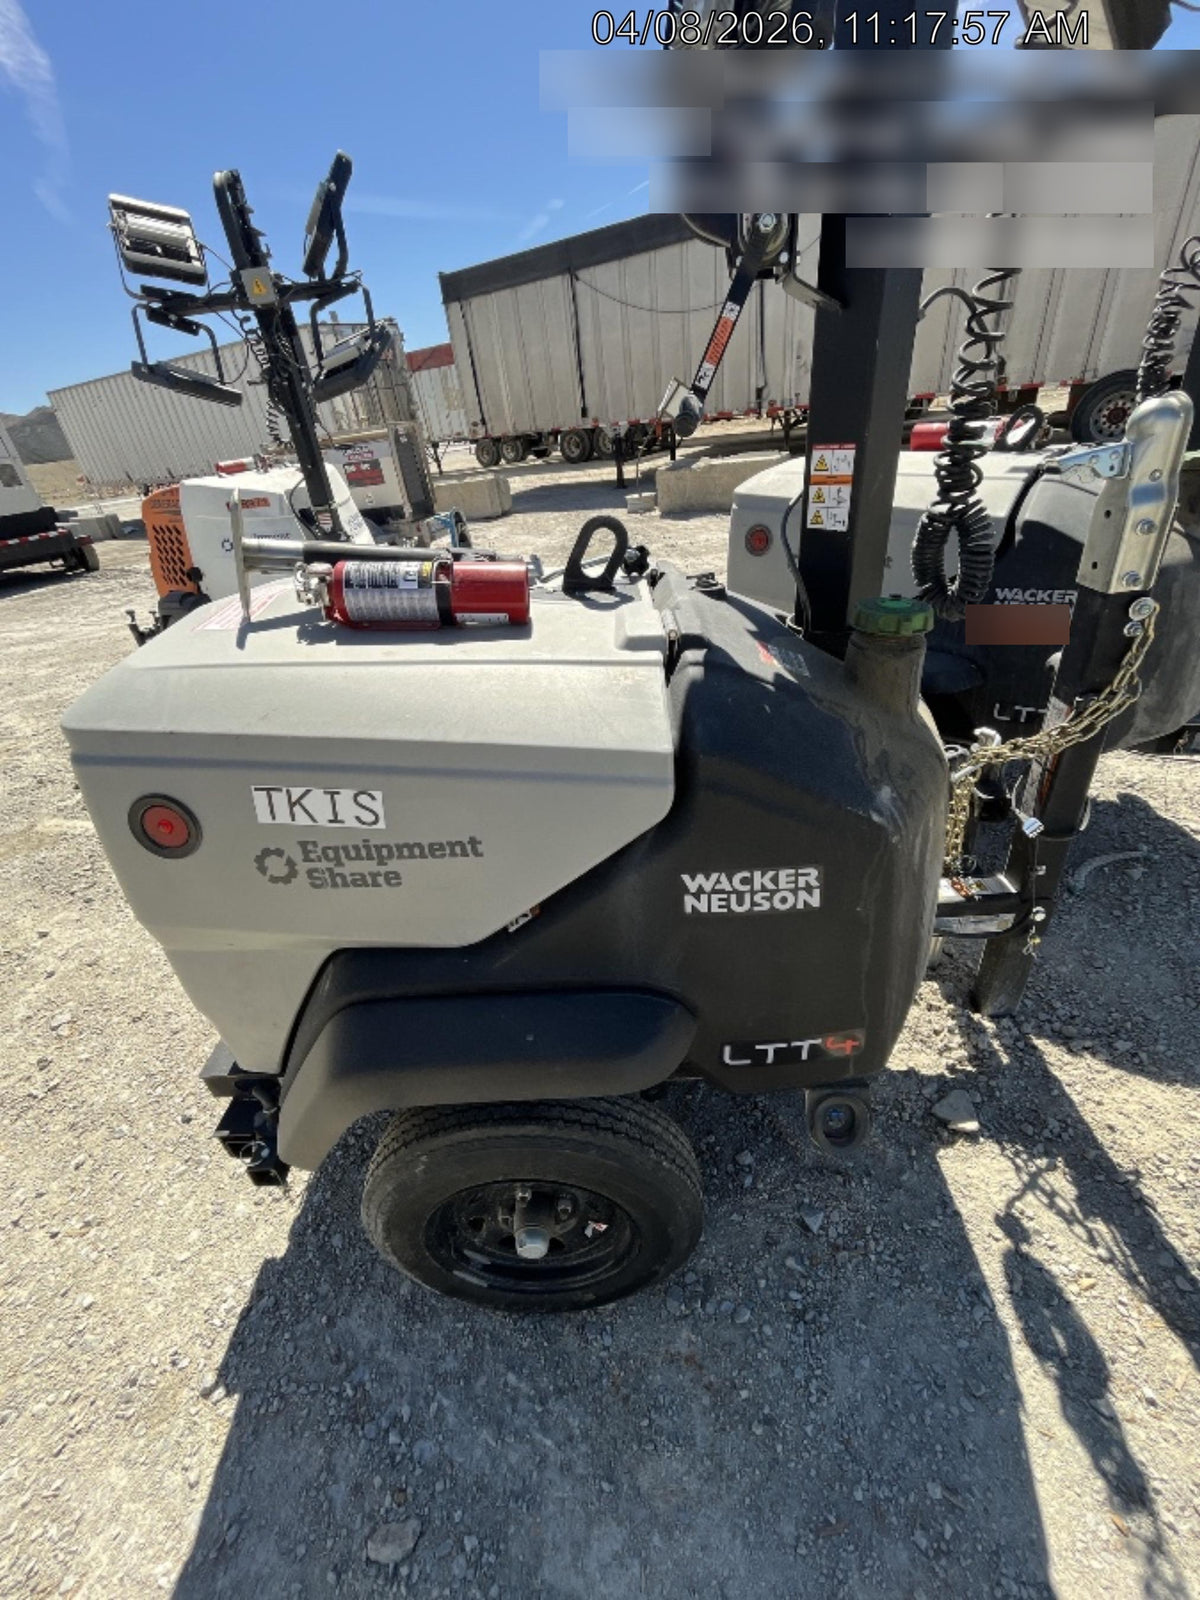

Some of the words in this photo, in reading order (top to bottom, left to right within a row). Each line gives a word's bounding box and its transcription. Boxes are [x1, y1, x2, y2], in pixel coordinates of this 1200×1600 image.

[995, 588, 1078, 604] WACKER
[254, 787, 380, 826] TKIS
[297, 836, 484, 867] Equipment
[306, 866, 402, 889] Share
[681, 868, 820, 893] WACKER
[684, 889, 820, 914] NEUSON
[723, 1036, 859, 1066] LTT4
